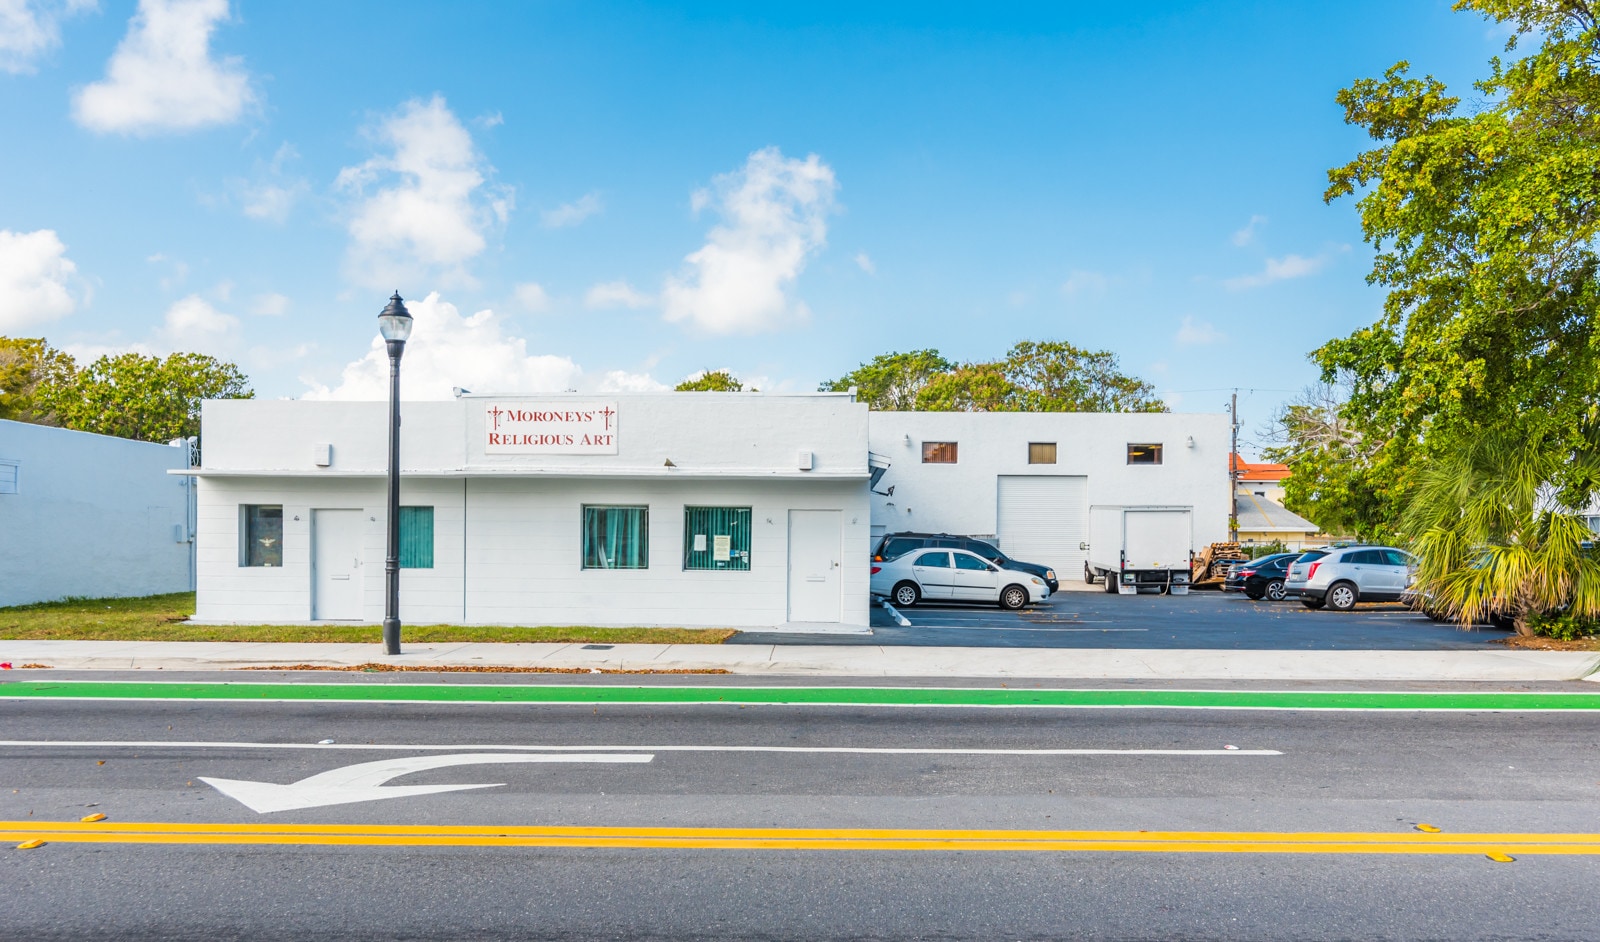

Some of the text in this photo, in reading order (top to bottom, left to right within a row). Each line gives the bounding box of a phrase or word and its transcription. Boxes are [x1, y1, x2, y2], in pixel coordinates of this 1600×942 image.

[507, 409, 596, 422] MORONEYS'
[488, 432, 613, 446] RELIGIOUS ART
